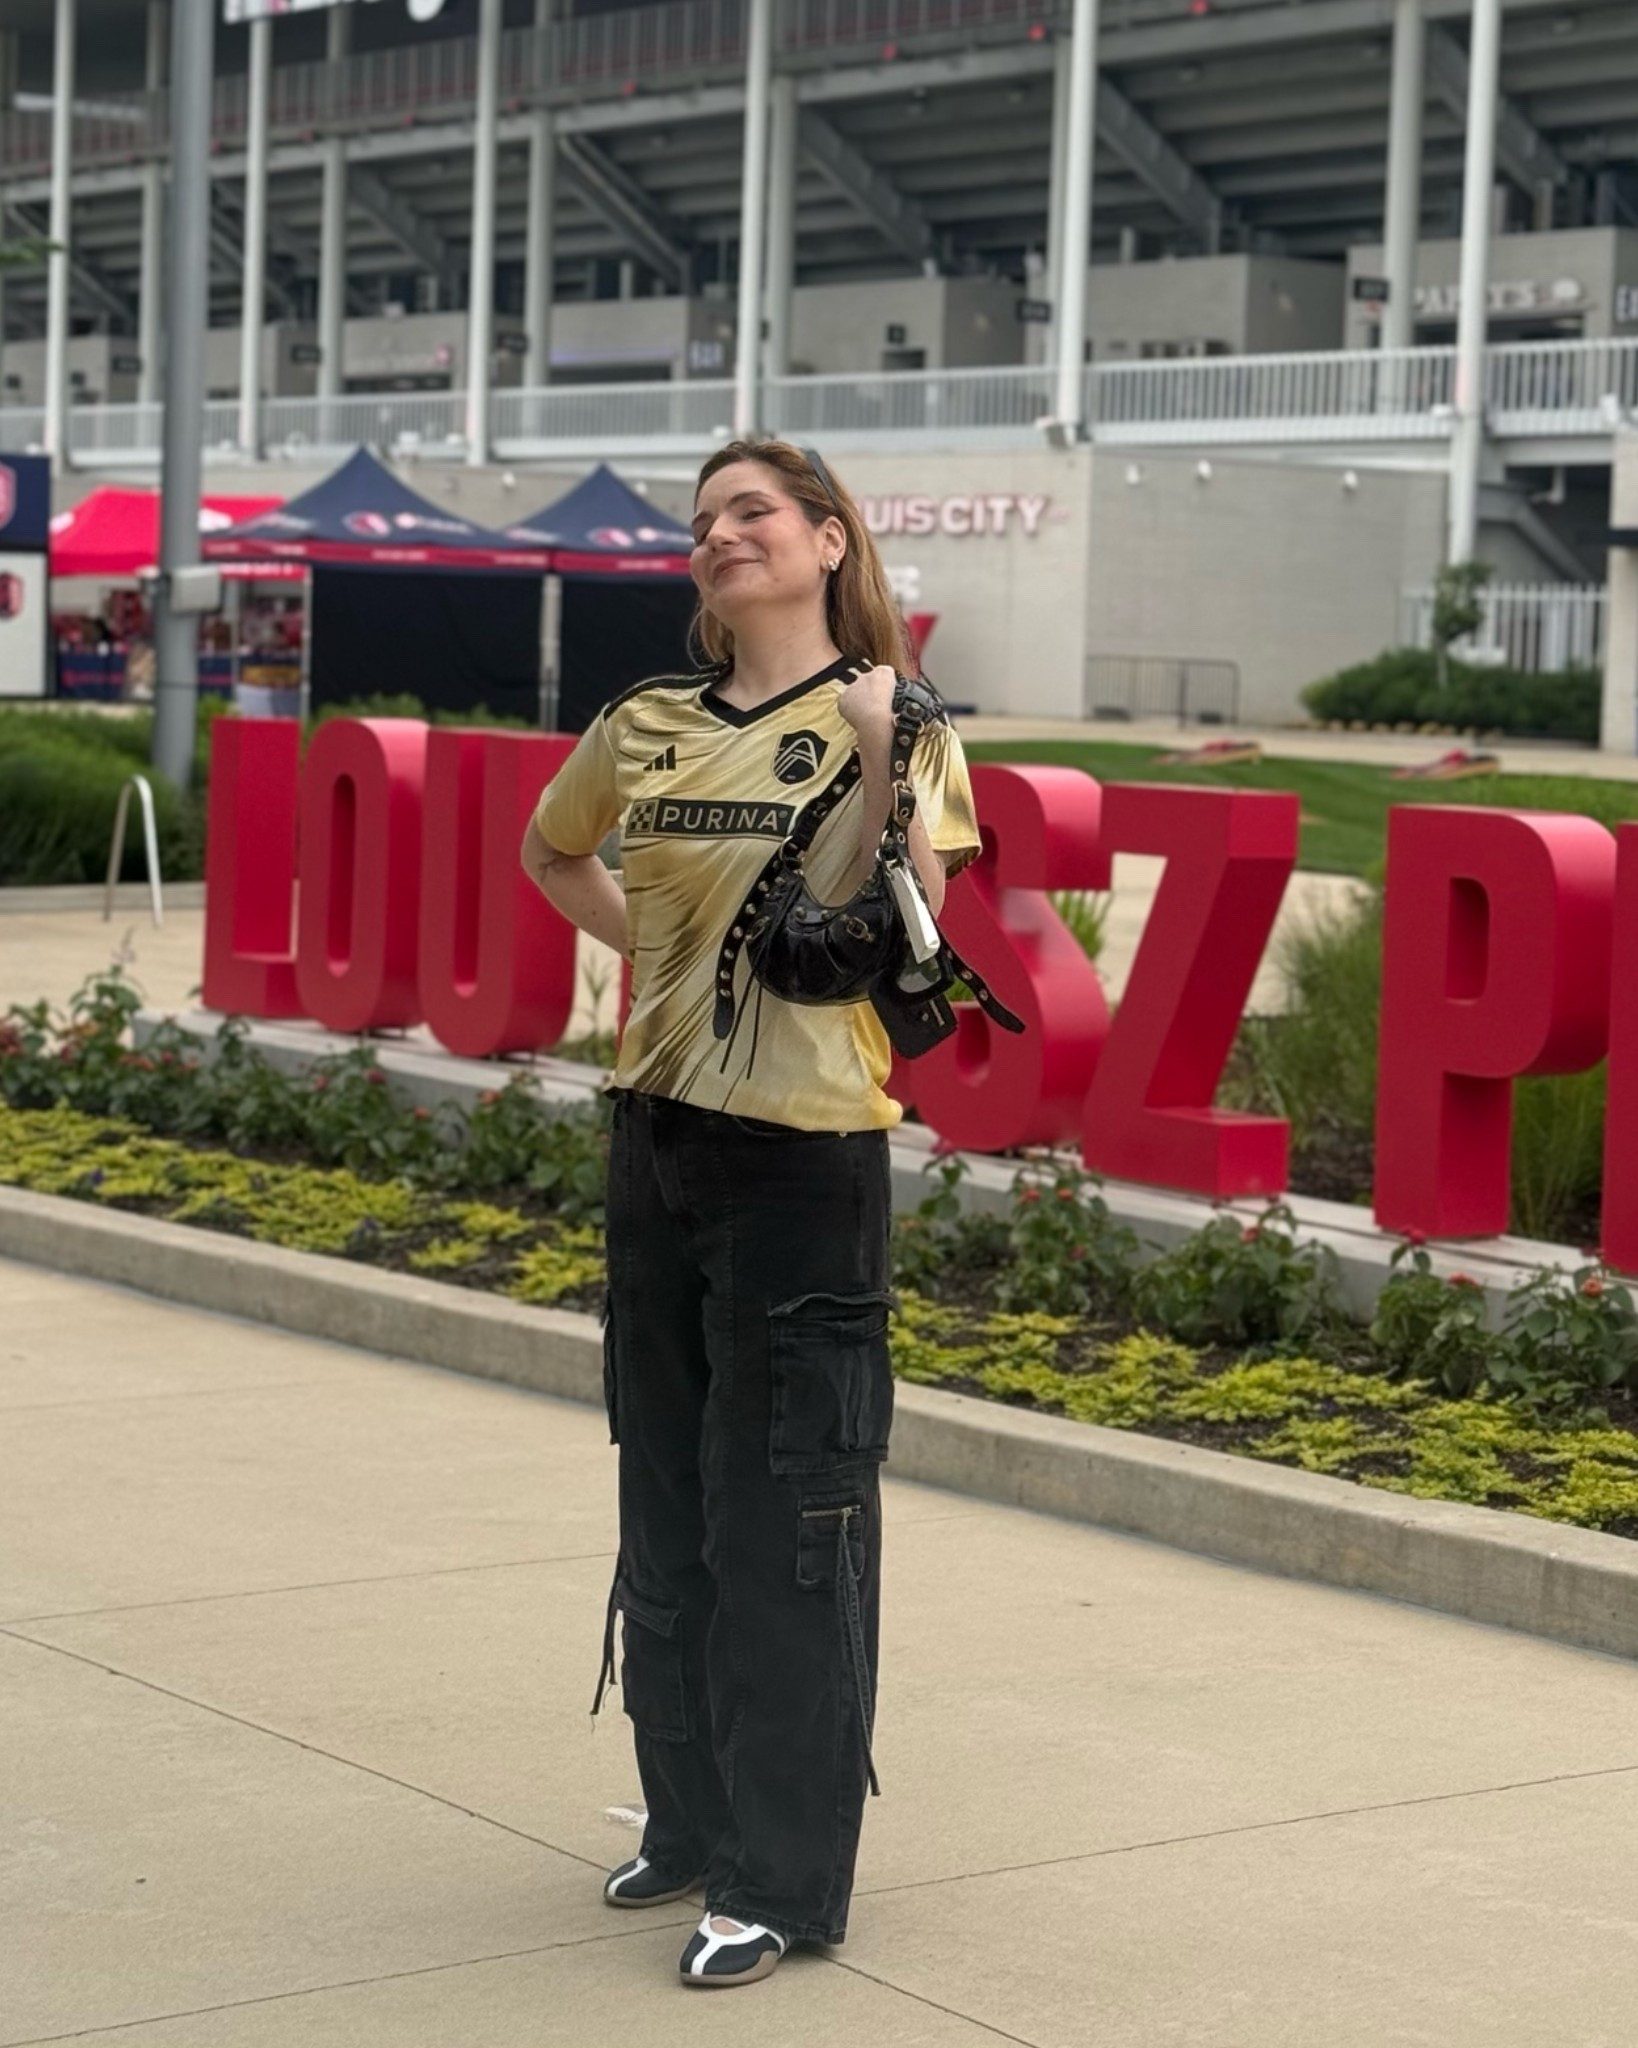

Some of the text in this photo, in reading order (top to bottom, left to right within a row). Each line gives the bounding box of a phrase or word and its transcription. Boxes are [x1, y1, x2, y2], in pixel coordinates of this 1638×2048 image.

[862, 495, 1048, 535] UIS CITY
[660, 805, 778, 831] PURINA
